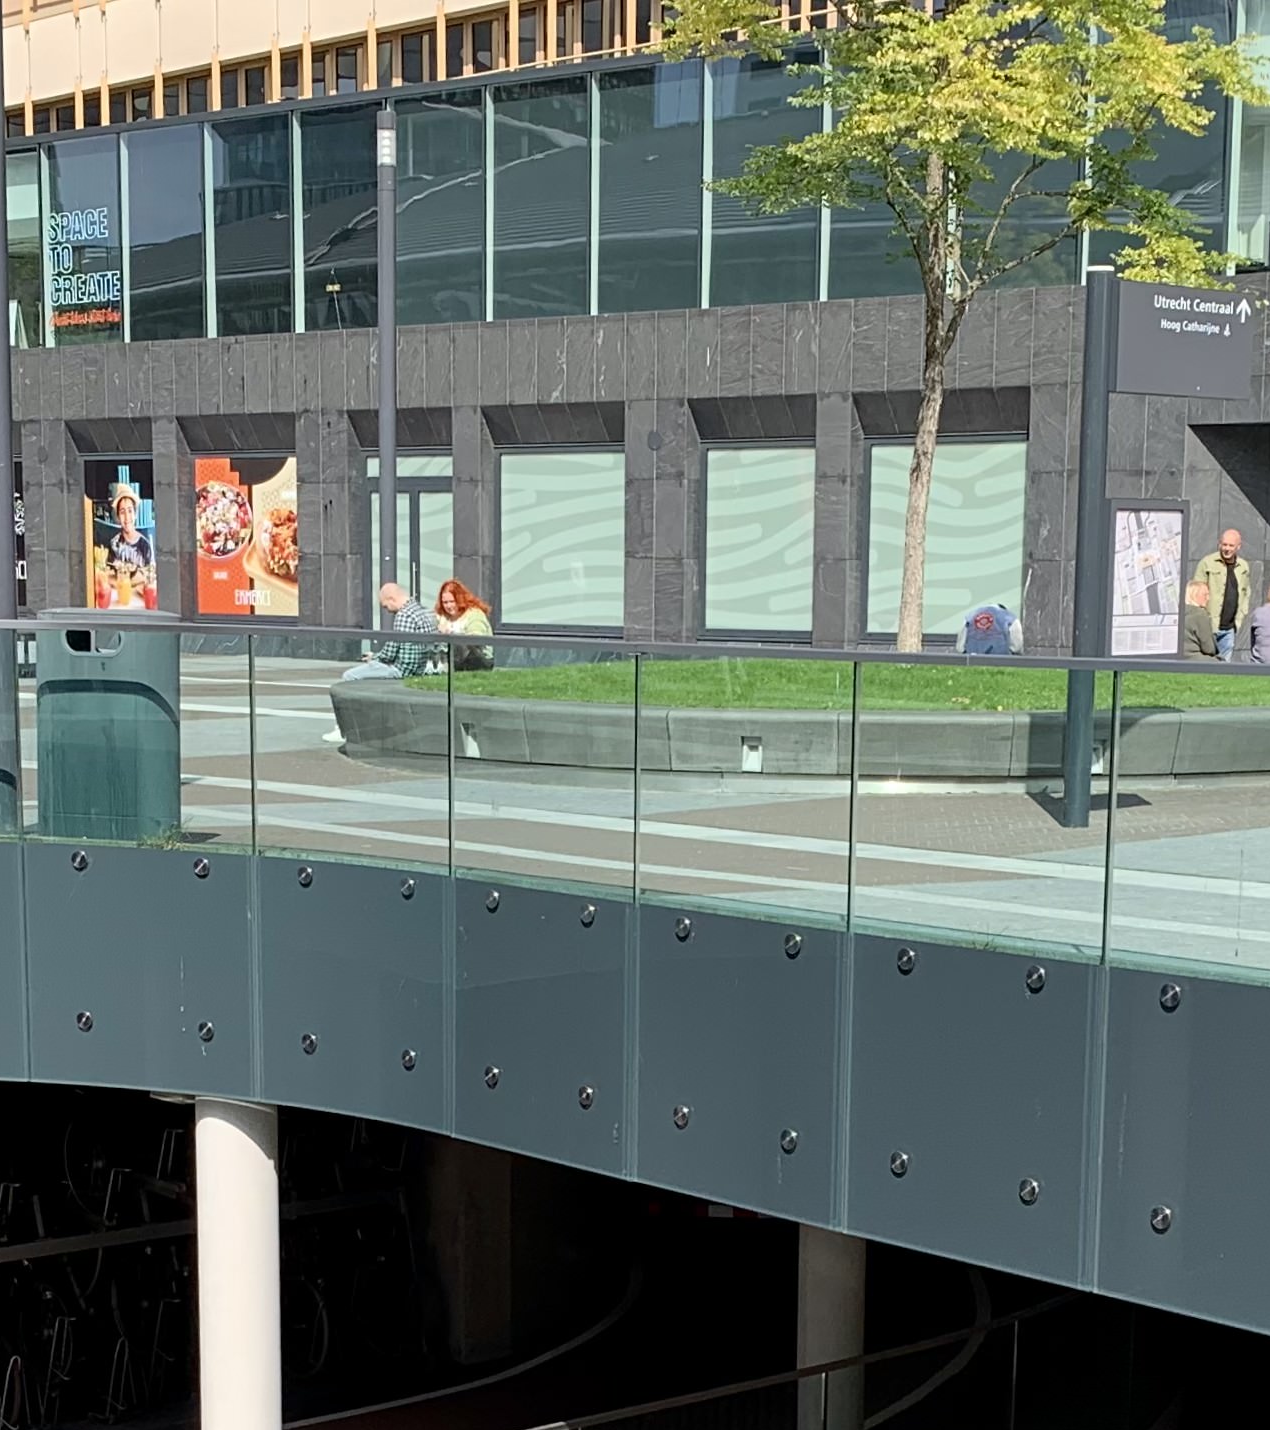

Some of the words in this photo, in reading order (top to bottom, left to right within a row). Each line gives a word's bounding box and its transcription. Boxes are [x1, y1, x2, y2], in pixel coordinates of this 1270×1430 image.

[48, 207, 109, 244] SPACE
[49, 244, 73, 275] TO
[50, 270, 121, 306] CREATE
[1153, 295, 1191, 311] Utrecht
[1193, 299, 1234, 315] Centraal
[1160, 318, 1181, 333] Hoog
[1182, 320, 1220, 335] Catharijne
